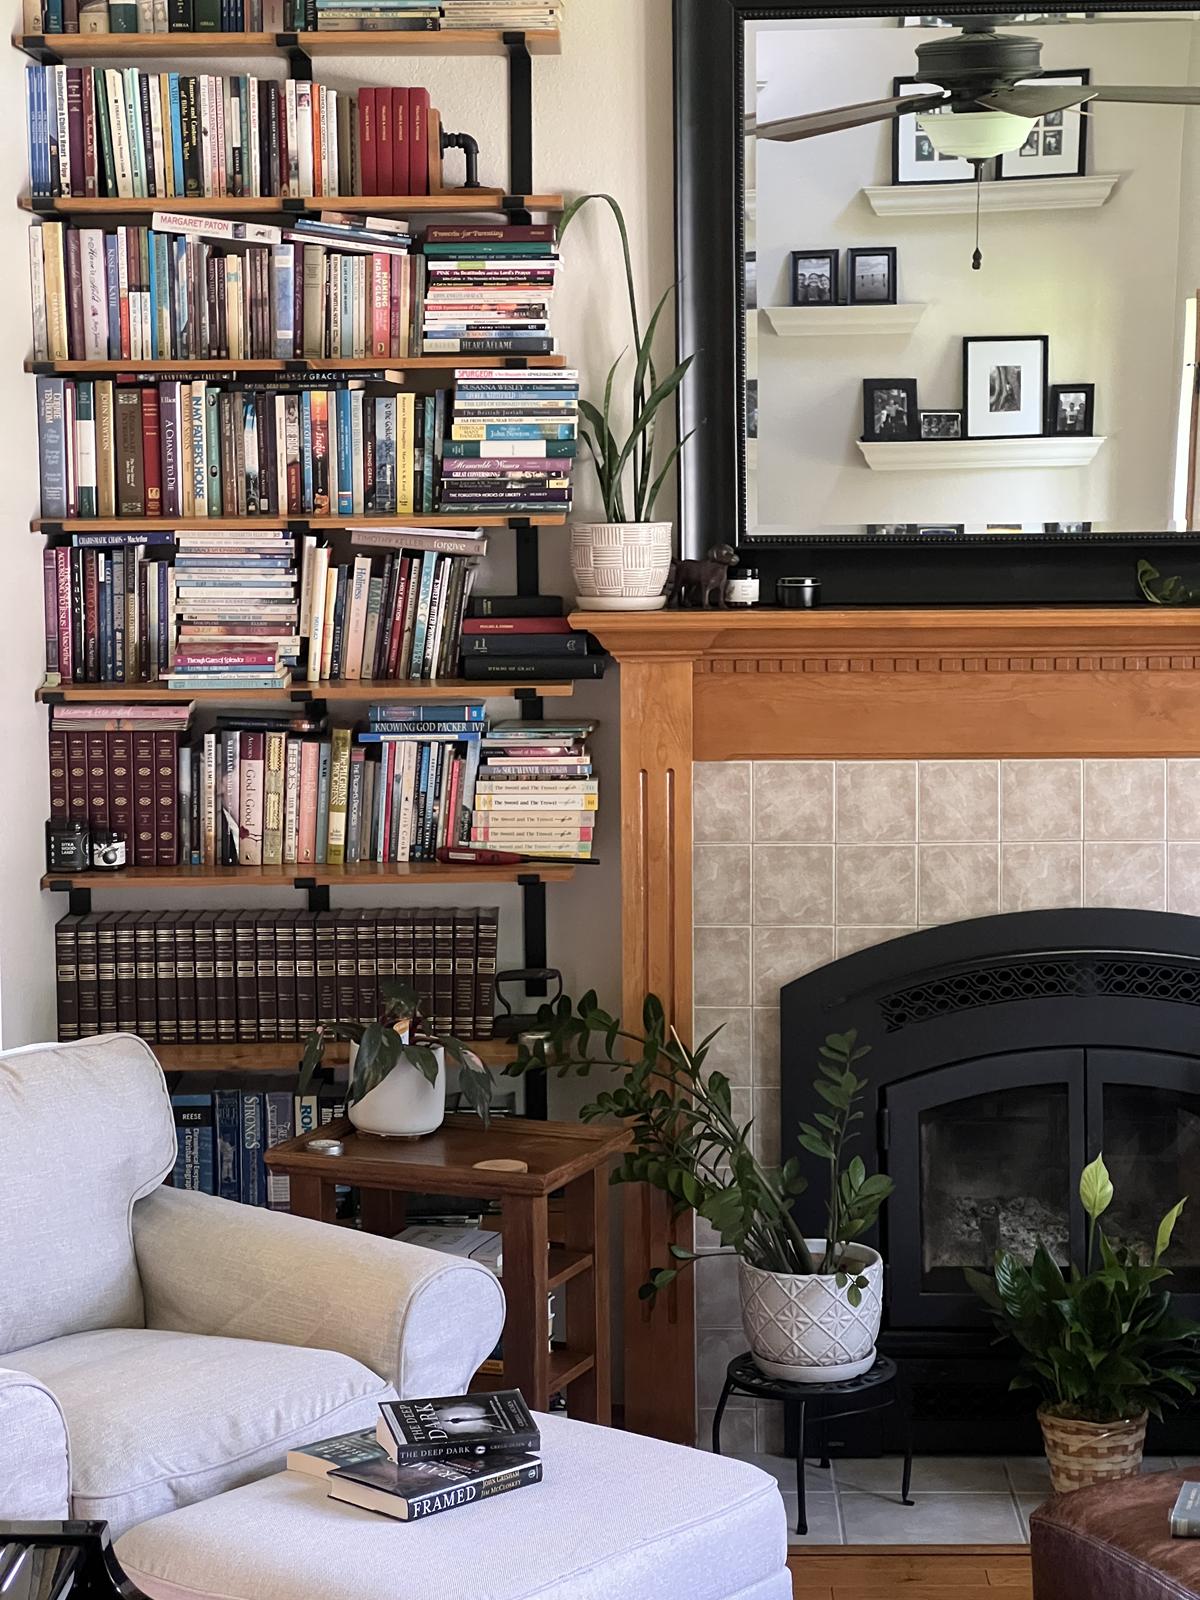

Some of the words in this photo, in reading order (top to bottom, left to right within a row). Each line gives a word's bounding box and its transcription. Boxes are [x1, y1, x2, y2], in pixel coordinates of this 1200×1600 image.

[57, 71, 66, 111] Shepherding
[160, 215, 203, 227] MARGARET
[204, 221, 229, 231] PATON
[108, 249, 116, 273] KISSES
[462, 340, 483, 350] HEART
[486, 340, 512, 350] AFLAME
[45, 388, 53, 403] TEN
[53, 393, 62, 419] CORRIE
[101, 393, 110, 414] JOHN
[192, 396, 202, 406] IN
[45, 403, 54, 423] BOOM
[165, 420, 173, 428] A
[193, 407, 203, 422] MY
[102, 416, 110, 450] NEWTON
[304, 430, 310, 441] OF
[385, 421, 393, 441] Golden
[165, 430, 175, 463] CHANCE
[193, 424, 203, 465] FATHER'S
[313, 432, 326, 459] India
[167, 464, 175, 476] TO
[167, 477, 176, 491] DIE
[194, 466, 204, 499] HOUSE
[78, 537, 107, 545] CHARISMATIC
[433, 539, 466, 551] forgive
[87, 563, 95, 581] TALE
[354, 567, 367, 600] Holiness
[59, 594, 66, 605] TO
[87, 586, 95, 608] TWO
[368, 579, 382, 614] MARK
[419, 567, 432, 609] DESIRING
[395, 596, 403, 621] AMBITION
[87, 610, 95, 634] SONS
[413, 641, 423, 664] PIPER
[425, 625, 434, 659] PROVIDENCE
[375, 722, 415, 732] KNOWING
[416, 722, 436, 732] GOD
[438, 722, 467, 732] PACKER
[472, 722, 485, 732] IVP
[340, 750, 348, 765] The
[245, 769, 256, 791] God
[331, 762, 340, 806] PROGRESS
[338, 765, 348, 806] PILGRIM'S
[352, 775, 360, 798] PILGRIM'S
[245, 798, 255, 827] Good
[401, 830, 409, 850] Cook
[244, 1096, 261, 1149] STRONG'S
[191, 1128, 199, 1165] Chronological
[184, 1164, 192, 1191] Biograph
[192, 1165, 200, 1191] Encyclop
[399, 1404, 418, 1425] DEEP
[415, 1403, 448, 1440] DARK
[409, 1425, 426, 1442] THE
[400, 1451, 419, 1459] THE
[446, 1446, 470, 1455] DARK
[413, 1486, 476, 1518] FRAMED
